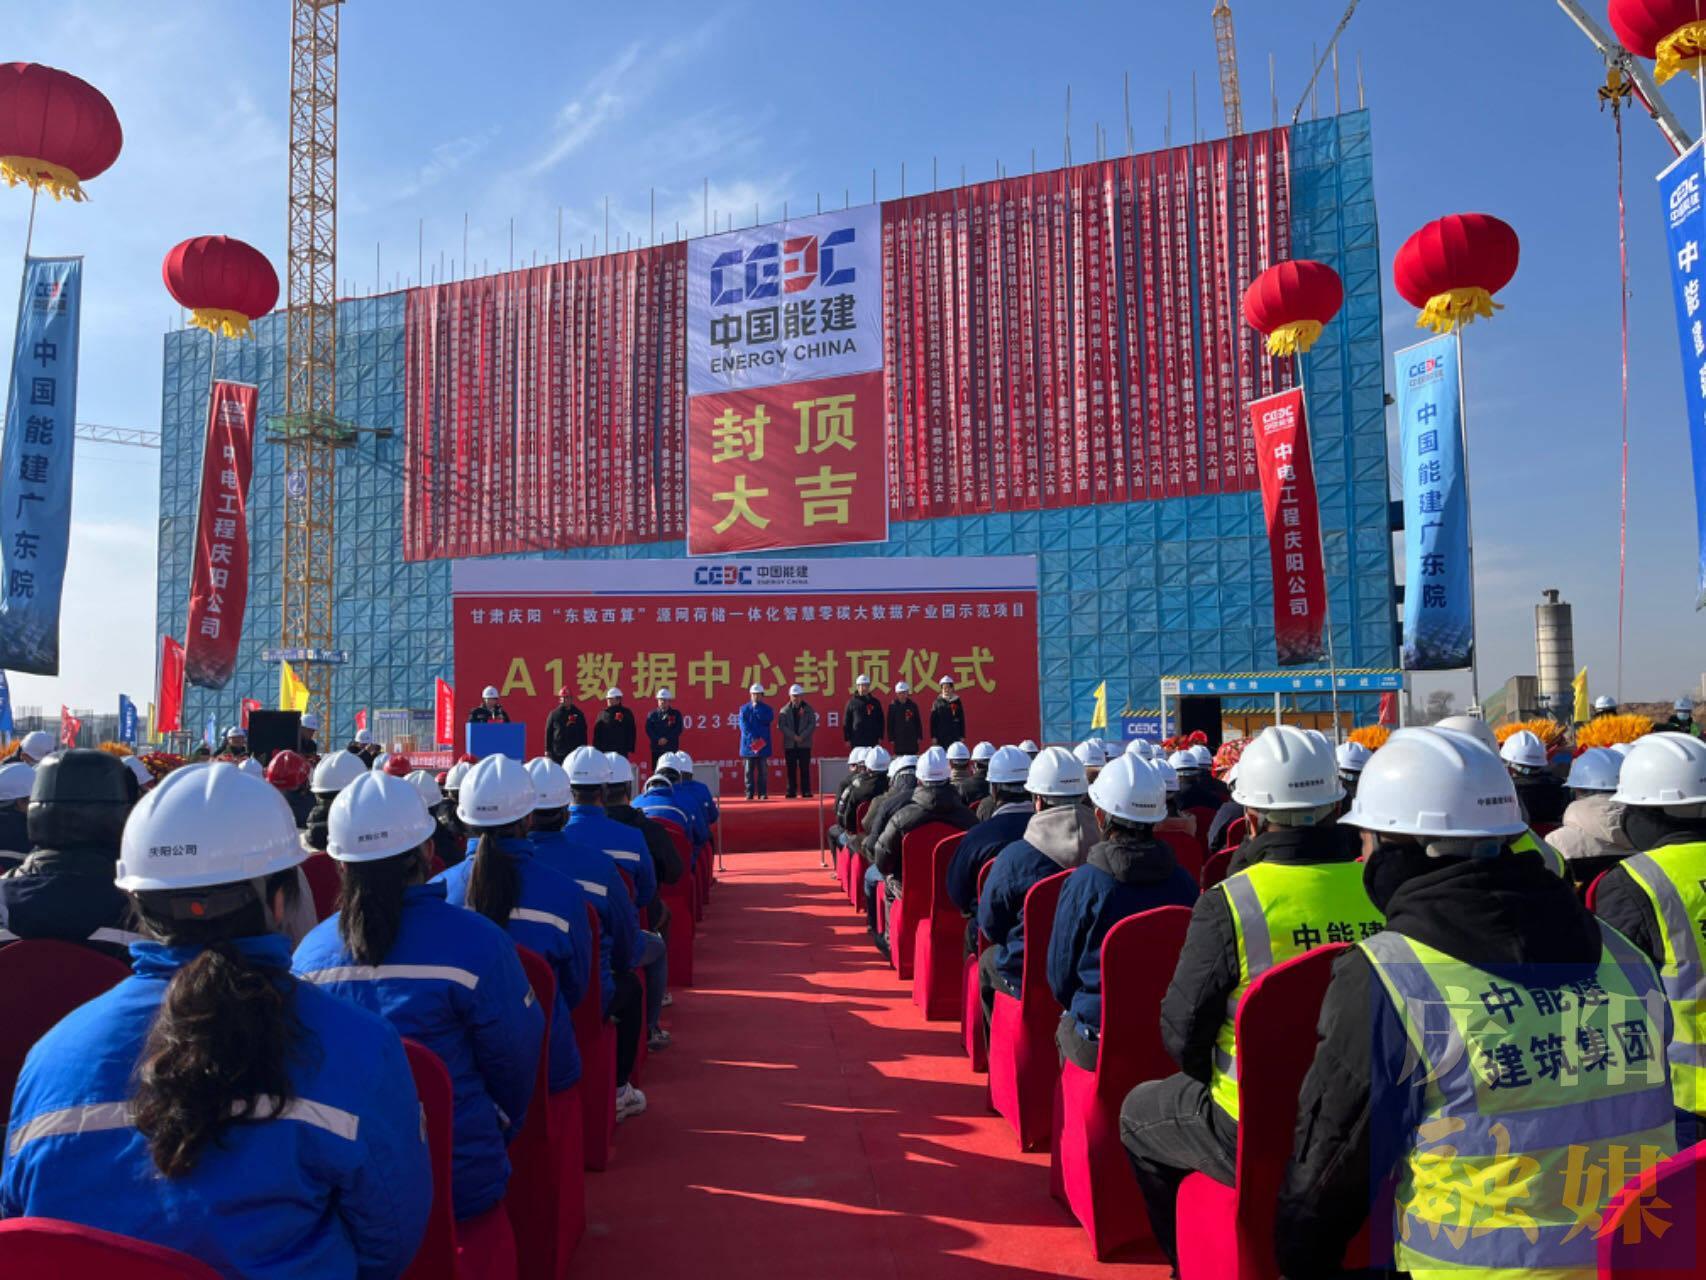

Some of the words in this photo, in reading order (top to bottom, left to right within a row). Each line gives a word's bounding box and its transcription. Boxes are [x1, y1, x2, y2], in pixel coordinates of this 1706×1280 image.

[711, 293, 857, 349] 中国能建
[711, 347, 788, 374] ENERGY
[793, 338, 857, 361] CHINA
[711, 393, 858, 464] 封顶
[9, 338, 57, 599] 中国能建广东院
[711, 465, 858, 535] 大吉
[1274, 442, 1309, 617] 中电工程庆阳公司
[1416, 401, 1448, 610] 中国能建广东院
[201, 445, 238, 640] 中电工程庆阳公司
[756, 565, 809, 578] 中国能建
[500, 646, 997, 701] A1数据中心封顶仪式
[149, 844, 198, 857] 庆阳公司
[1479, 978, 1610, 1024] 中能建
[1481, 1019, 1656, 1091] 建筑集团
